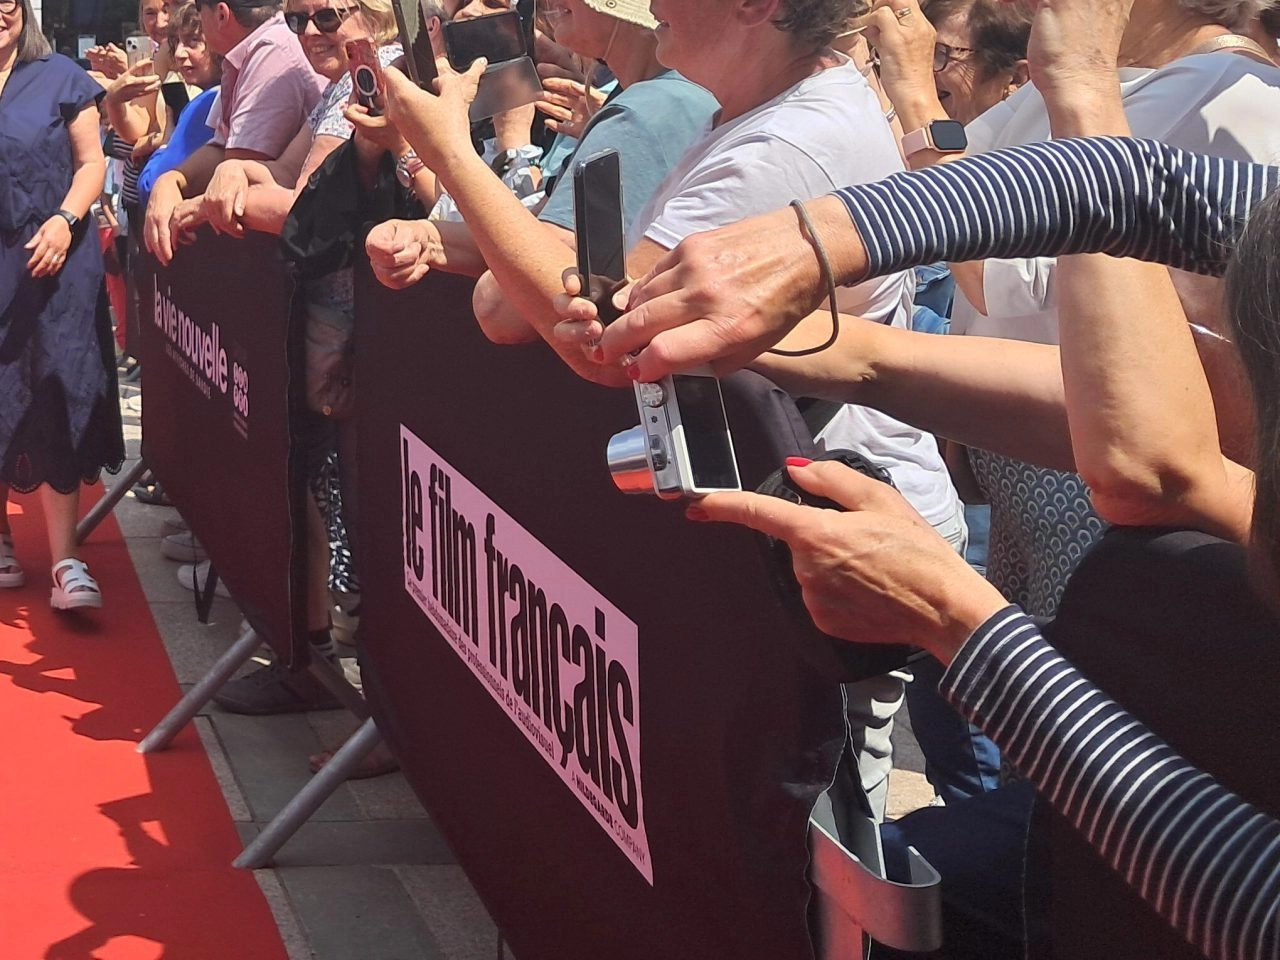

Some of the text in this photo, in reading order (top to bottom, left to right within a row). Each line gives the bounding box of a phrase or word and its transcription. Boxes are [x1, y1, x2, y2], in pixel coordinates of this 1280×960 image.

[154, 273, 162, 328] la
[162, 285, 178, 342] vie
[178, 309, 228, 394] nouvelle
[403, 437, 639, 830] le film français
